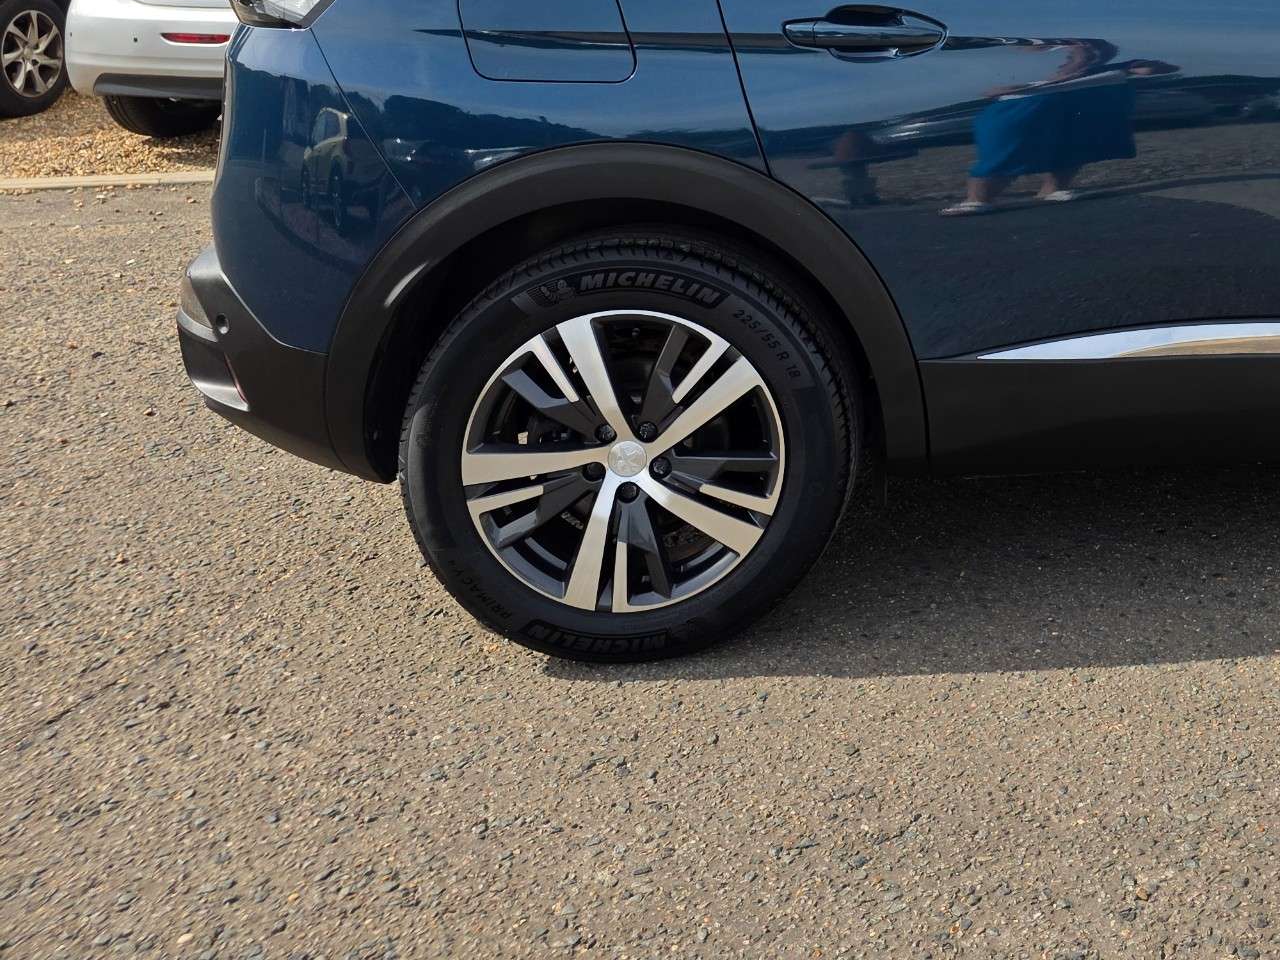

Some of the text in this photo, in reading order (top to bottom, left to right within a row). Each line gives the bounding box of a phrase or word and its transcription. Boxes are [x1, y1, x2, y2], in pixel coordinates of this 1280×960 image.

[579, 270, 723, 305] MICHELIN
[733, 308, 801, 378] 225/55 R 18
